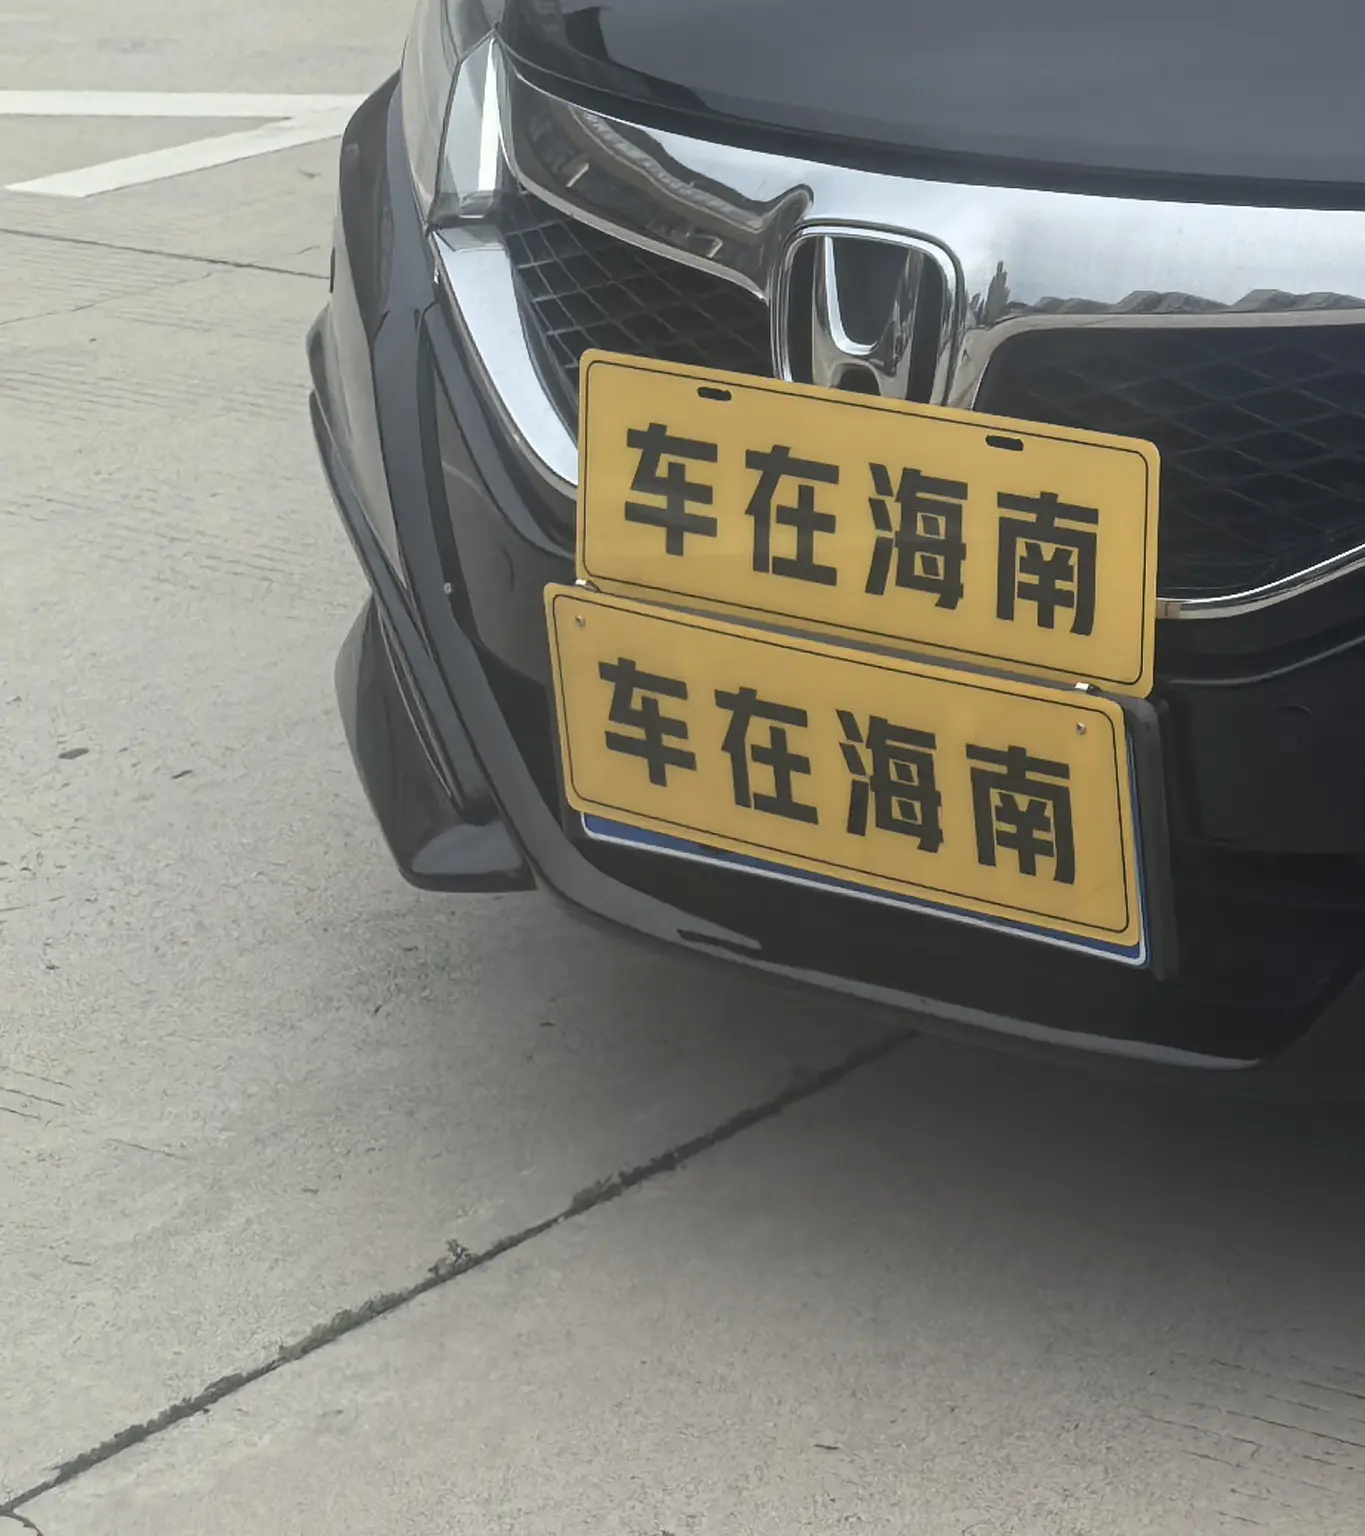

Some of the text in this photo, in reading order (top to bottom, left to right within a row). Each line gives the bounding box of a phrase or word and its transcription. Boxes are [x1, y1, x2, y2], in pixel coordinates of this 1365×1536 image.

[624, 422, 1099, 636] 车在海南
[598, 656, 1075, 885] 车在海南
